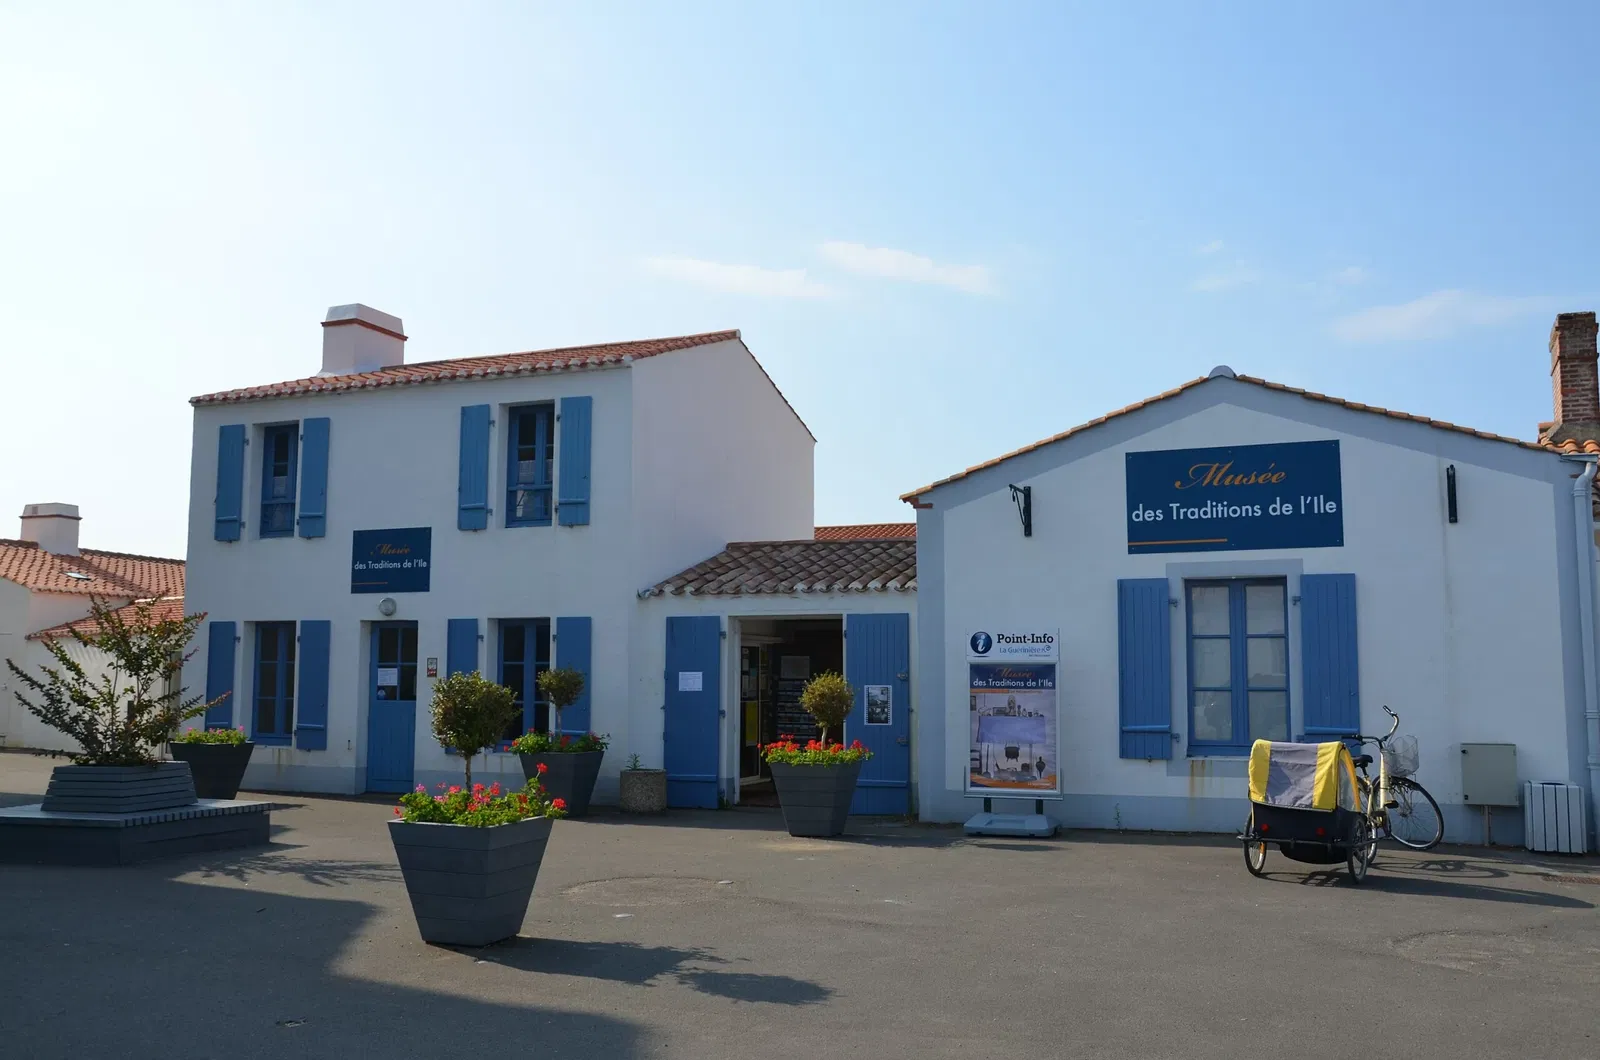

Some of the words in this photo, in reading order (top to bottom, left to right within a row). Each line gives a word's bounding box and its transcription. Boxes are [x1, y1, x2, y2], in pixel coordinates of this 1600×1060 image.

[1174, 460, 1287, 490] Musée
[1131, 503, 1164, 522] des
[1169, 500, 1262, 521] Traditions
[1268, 497, 1293, 516] de
[1300, 494, 1337, 515] l'Ile
[354, 561, 366, 570] des
[367, 560, 401, 569] Traditions
[402, 559, 412, 568] de
[413, 558, 427, 568] l'Ile
[996, 633, 1054, 644] Point-Info
[973, 678, 986, 687] des
[988, 678, 1024, 687] Traditions
[1026, 679, 1037, 687] de
[1038, 678, 1053, 687] l'Ile
